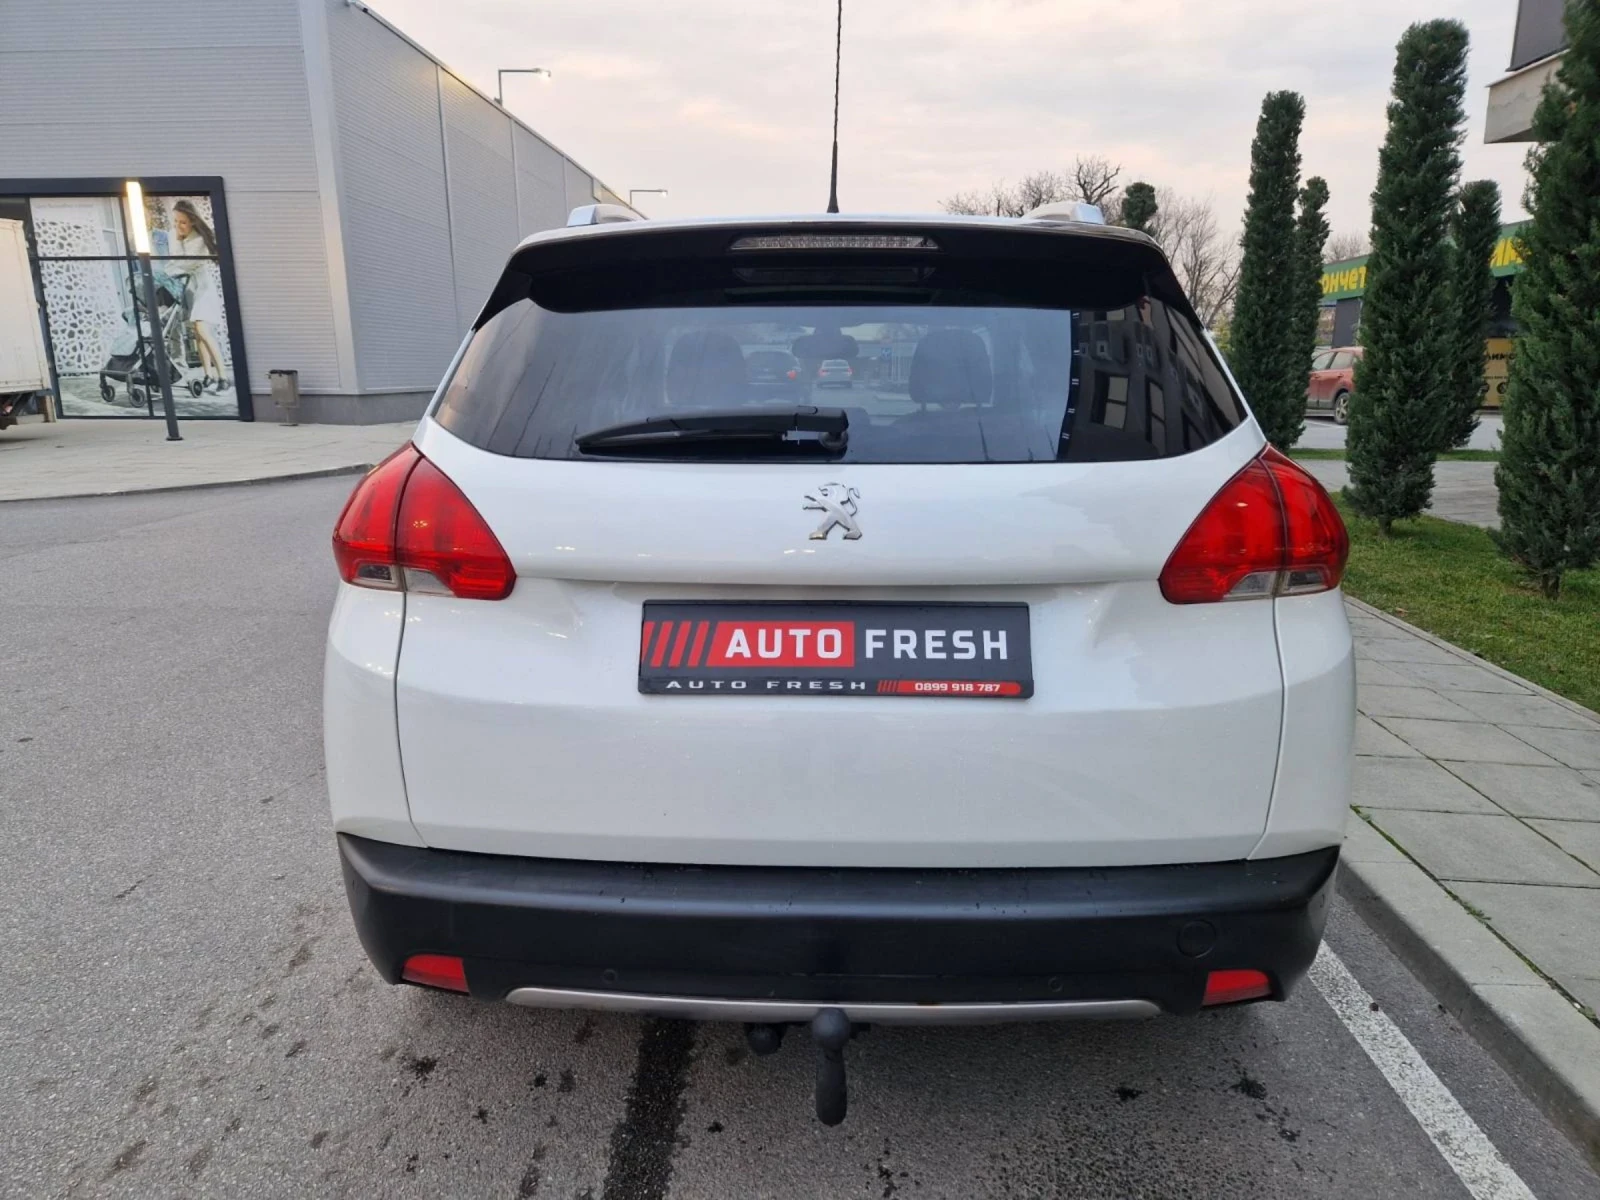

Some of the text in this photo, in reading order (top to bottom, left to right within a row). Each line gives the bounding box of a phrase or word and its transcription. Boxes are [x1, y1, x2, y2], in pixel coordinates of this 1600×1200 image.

[725, 628, 1008, 660] AUTO FRESH
[666, 680, 866, 690] AUTO FRESH
[914, 682, 1001, 693] 0899 918 787
